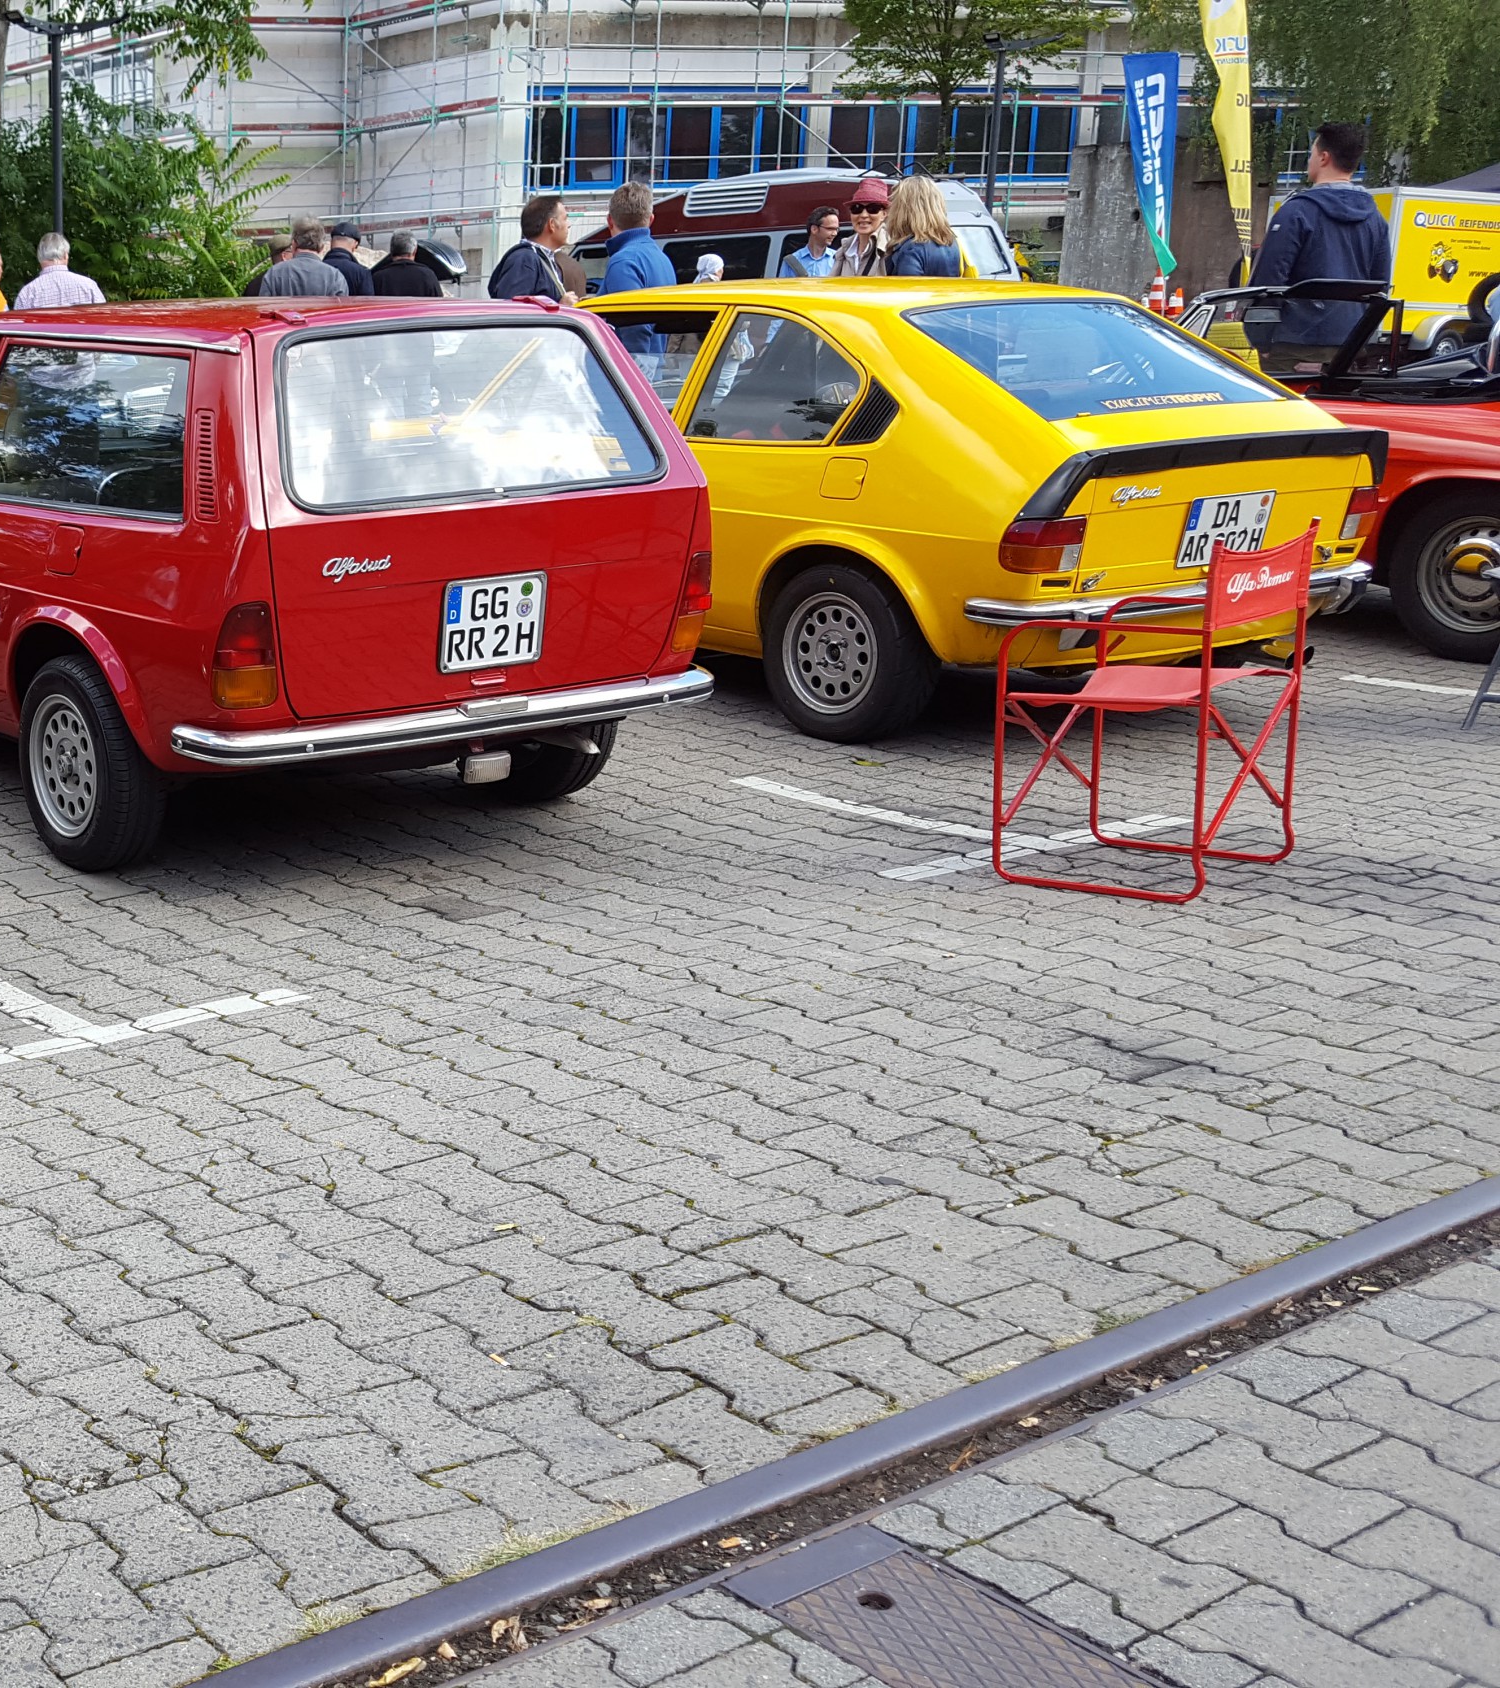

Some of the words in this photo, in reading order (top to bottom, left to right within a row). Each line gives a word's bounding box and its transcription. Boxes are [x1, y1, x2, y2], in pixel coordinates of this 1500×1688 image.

[1414, 211, 1457, 228] QUICK
[1211, 499, 1242, 529] DA
[1180, 531, 1210, 563] AR
[322, 554, 392, 583] Alfasud
[1226, 571, 1257, 603] Alfa
[1256, 565, 1295, 590] Romeo
[449, 609, 457, 620] D
[470, 585, 509, 622] GG
[447, 626, 486, 663] RR
